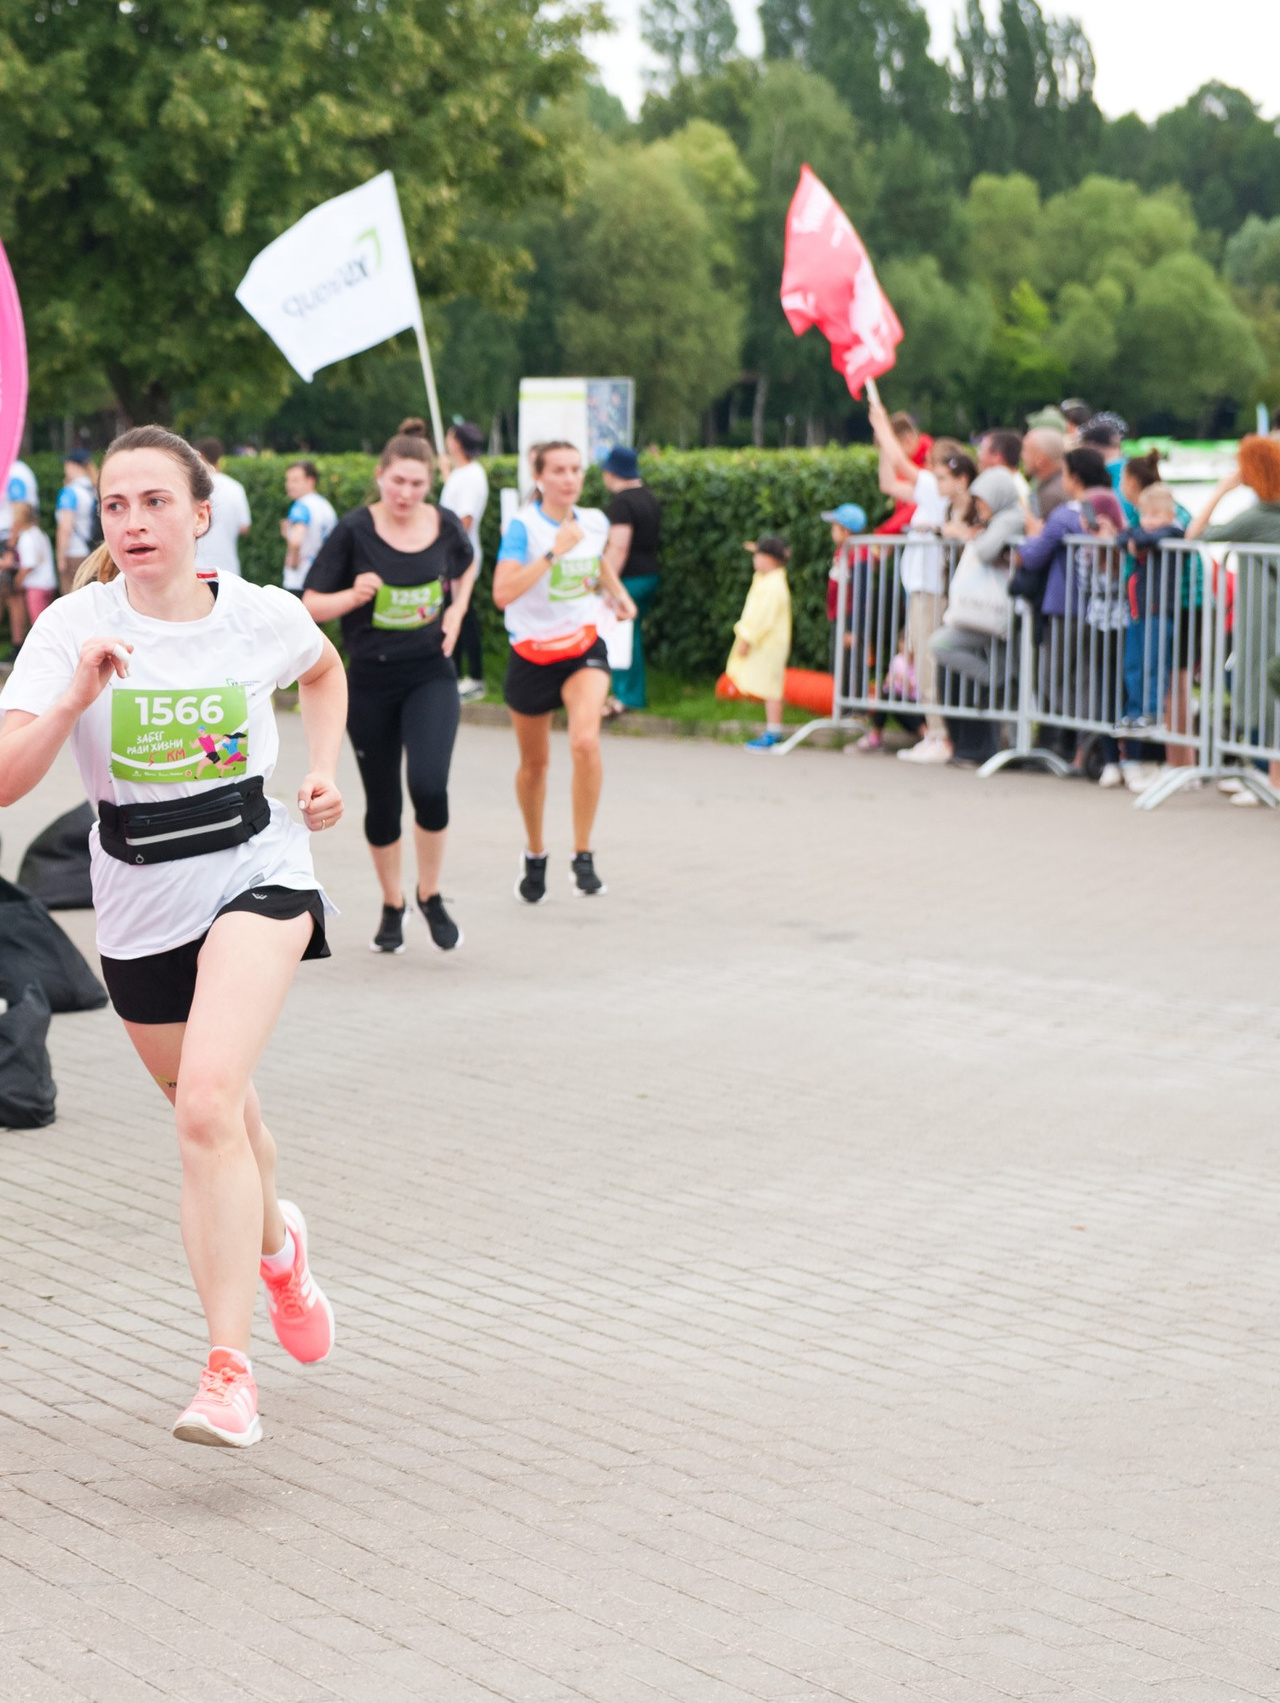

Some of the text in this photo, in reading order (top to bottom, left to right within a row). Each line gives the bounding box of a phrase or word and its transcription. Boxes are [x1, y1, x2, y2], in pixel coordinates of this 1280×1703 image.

[135, 695, 224, 726] 1566
[136, 730, 165, 745] ЗАБЕГ
[126, 745, 149, 755] РАДИ
